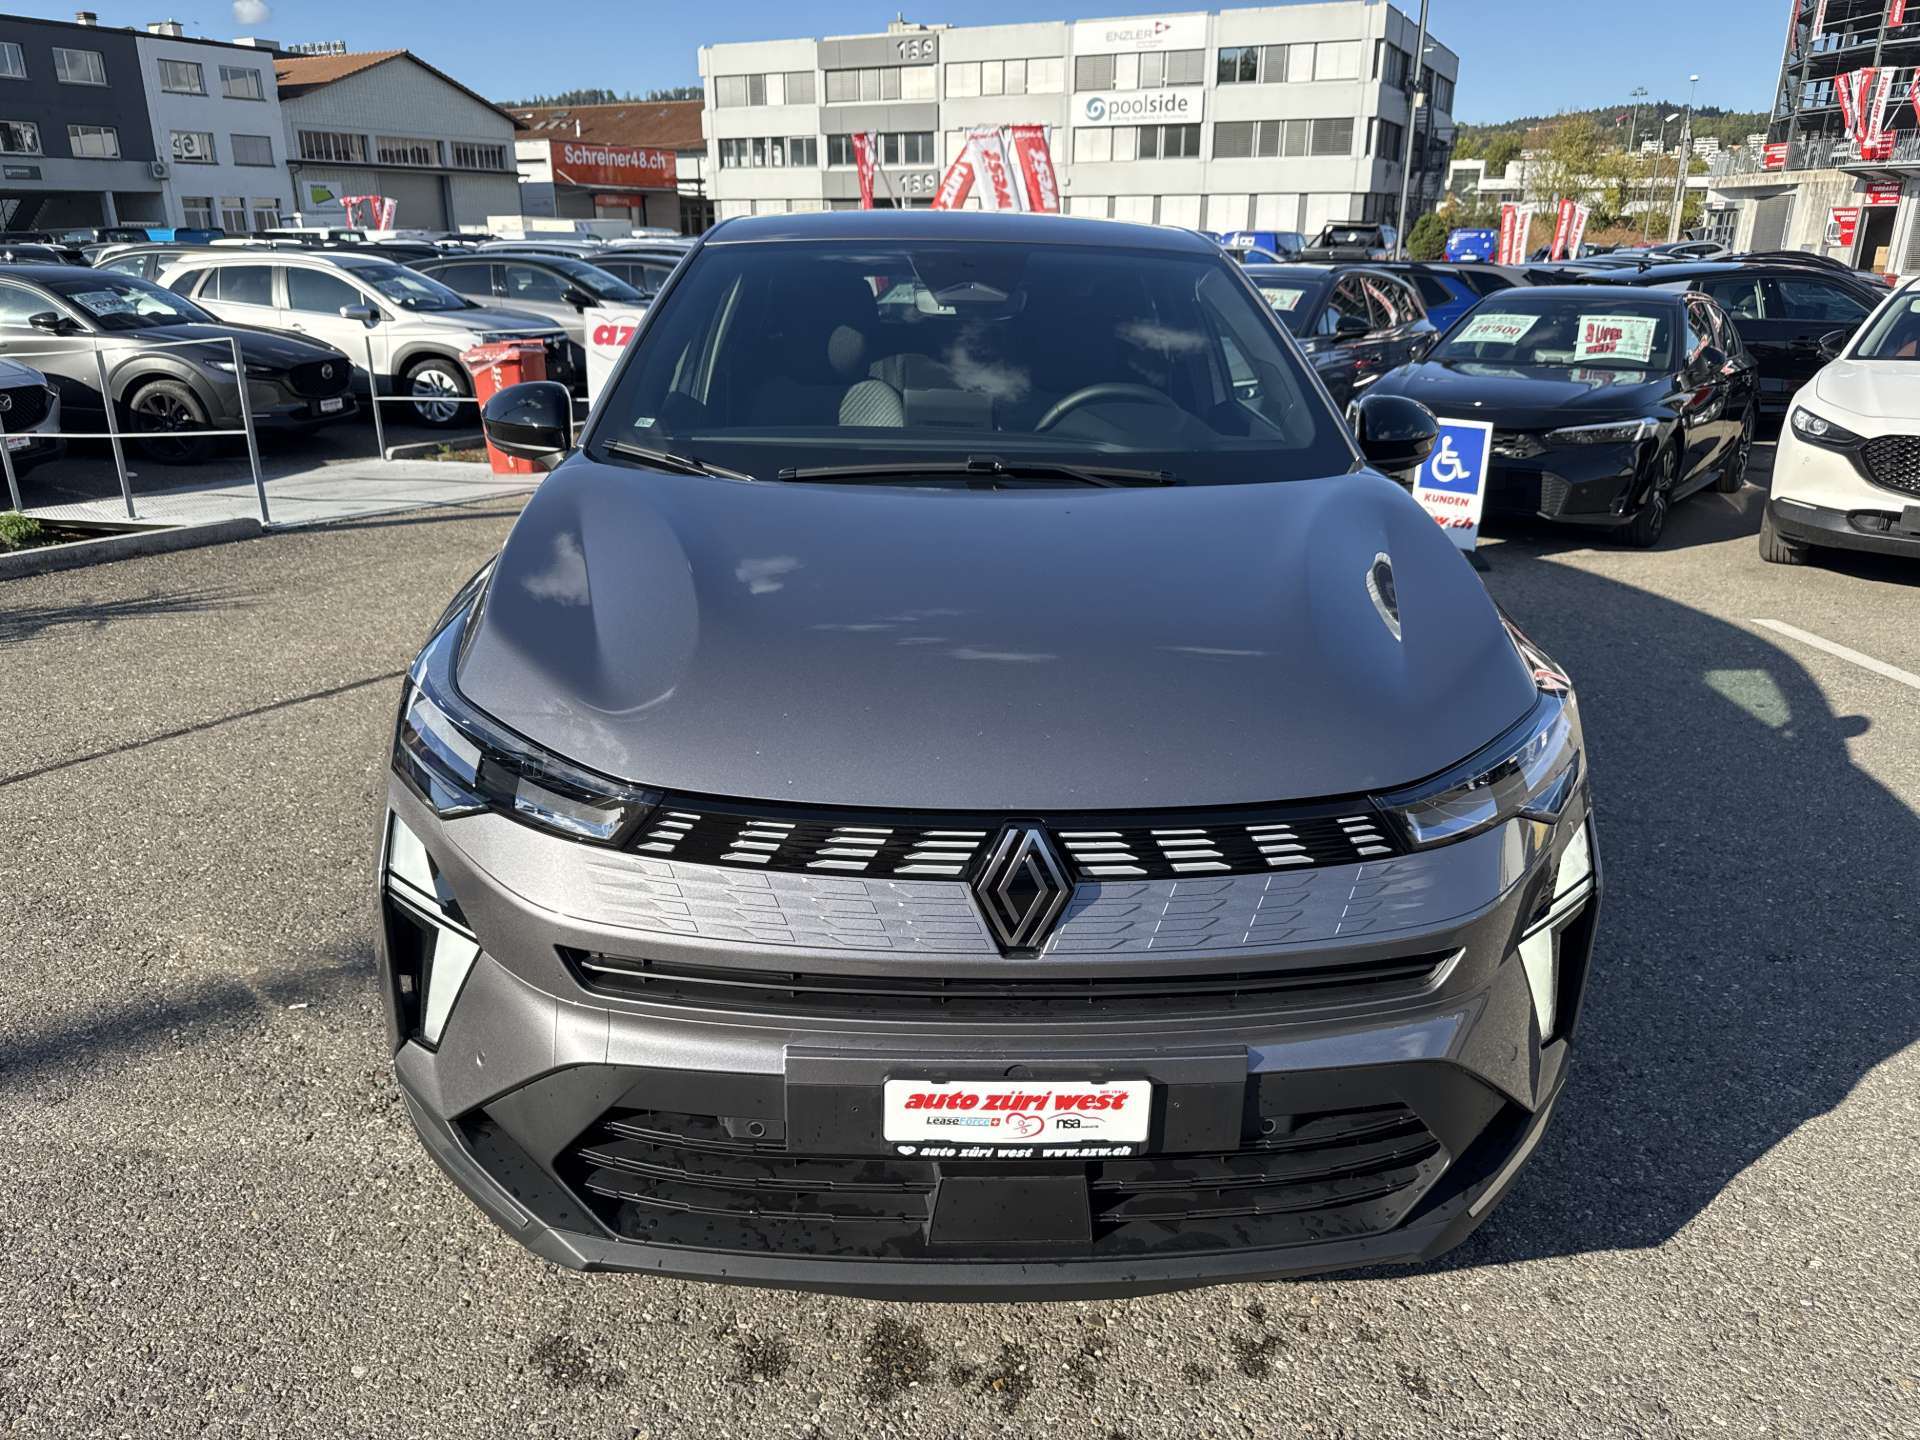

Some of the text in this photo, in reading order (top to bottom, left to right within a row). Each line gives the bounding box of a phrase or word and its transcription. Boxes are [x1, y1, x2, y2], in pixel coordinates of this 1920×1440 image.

[1106, 29, 1153, 42] ENZLER
[1109, 93, 1188, 121] poolside
[564, 145, 666, 169] Schreiner48.ch
[1424, 493, 1469, 507] KUNDEN
[904, 1091, 1129, 1111] auto züri west
[1056, 1118, 1081, 1129] nsa
[920, 1146, 1132, 1158] auto züri west www.azw.ch
